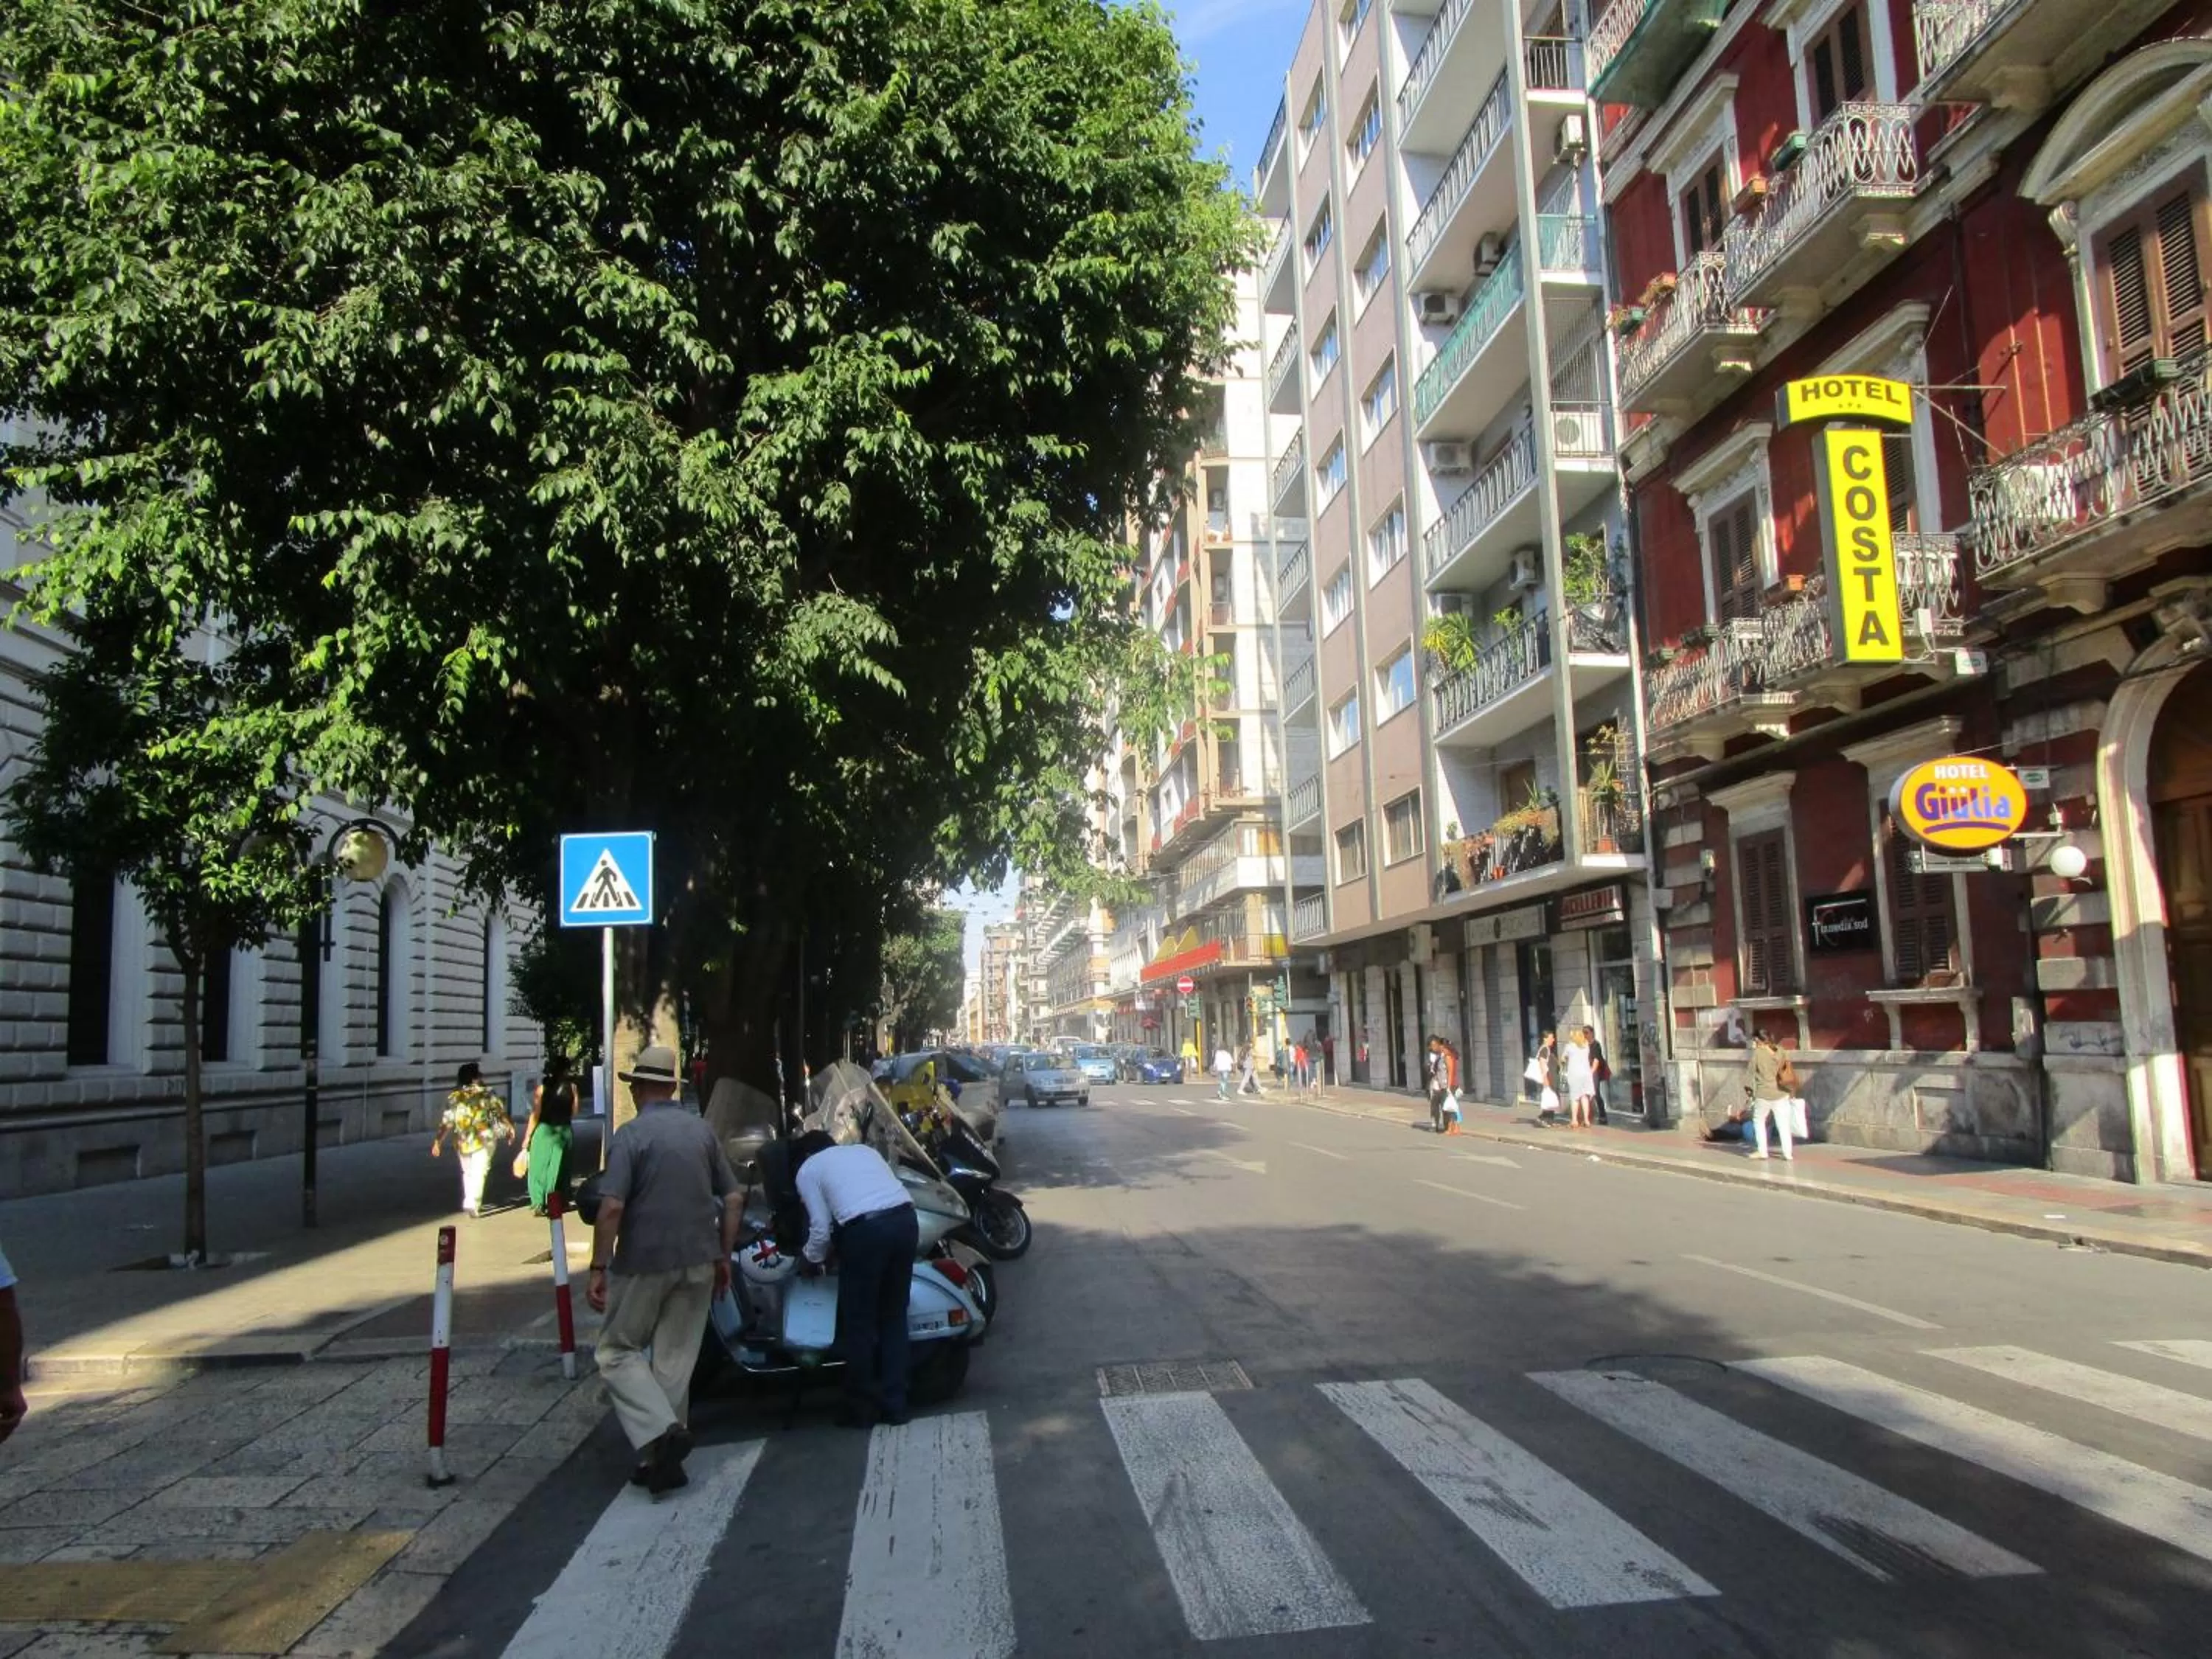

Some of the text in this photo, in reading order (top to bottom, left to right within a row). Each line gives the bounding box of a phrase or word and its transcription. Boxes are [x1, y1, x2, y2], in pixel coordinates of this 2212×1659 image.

[1801, 380, 1902, 406] HOTEL
[1843, 445, 1890, 646] COSTA
[1934, 764, 1989, 779] HOTEL
